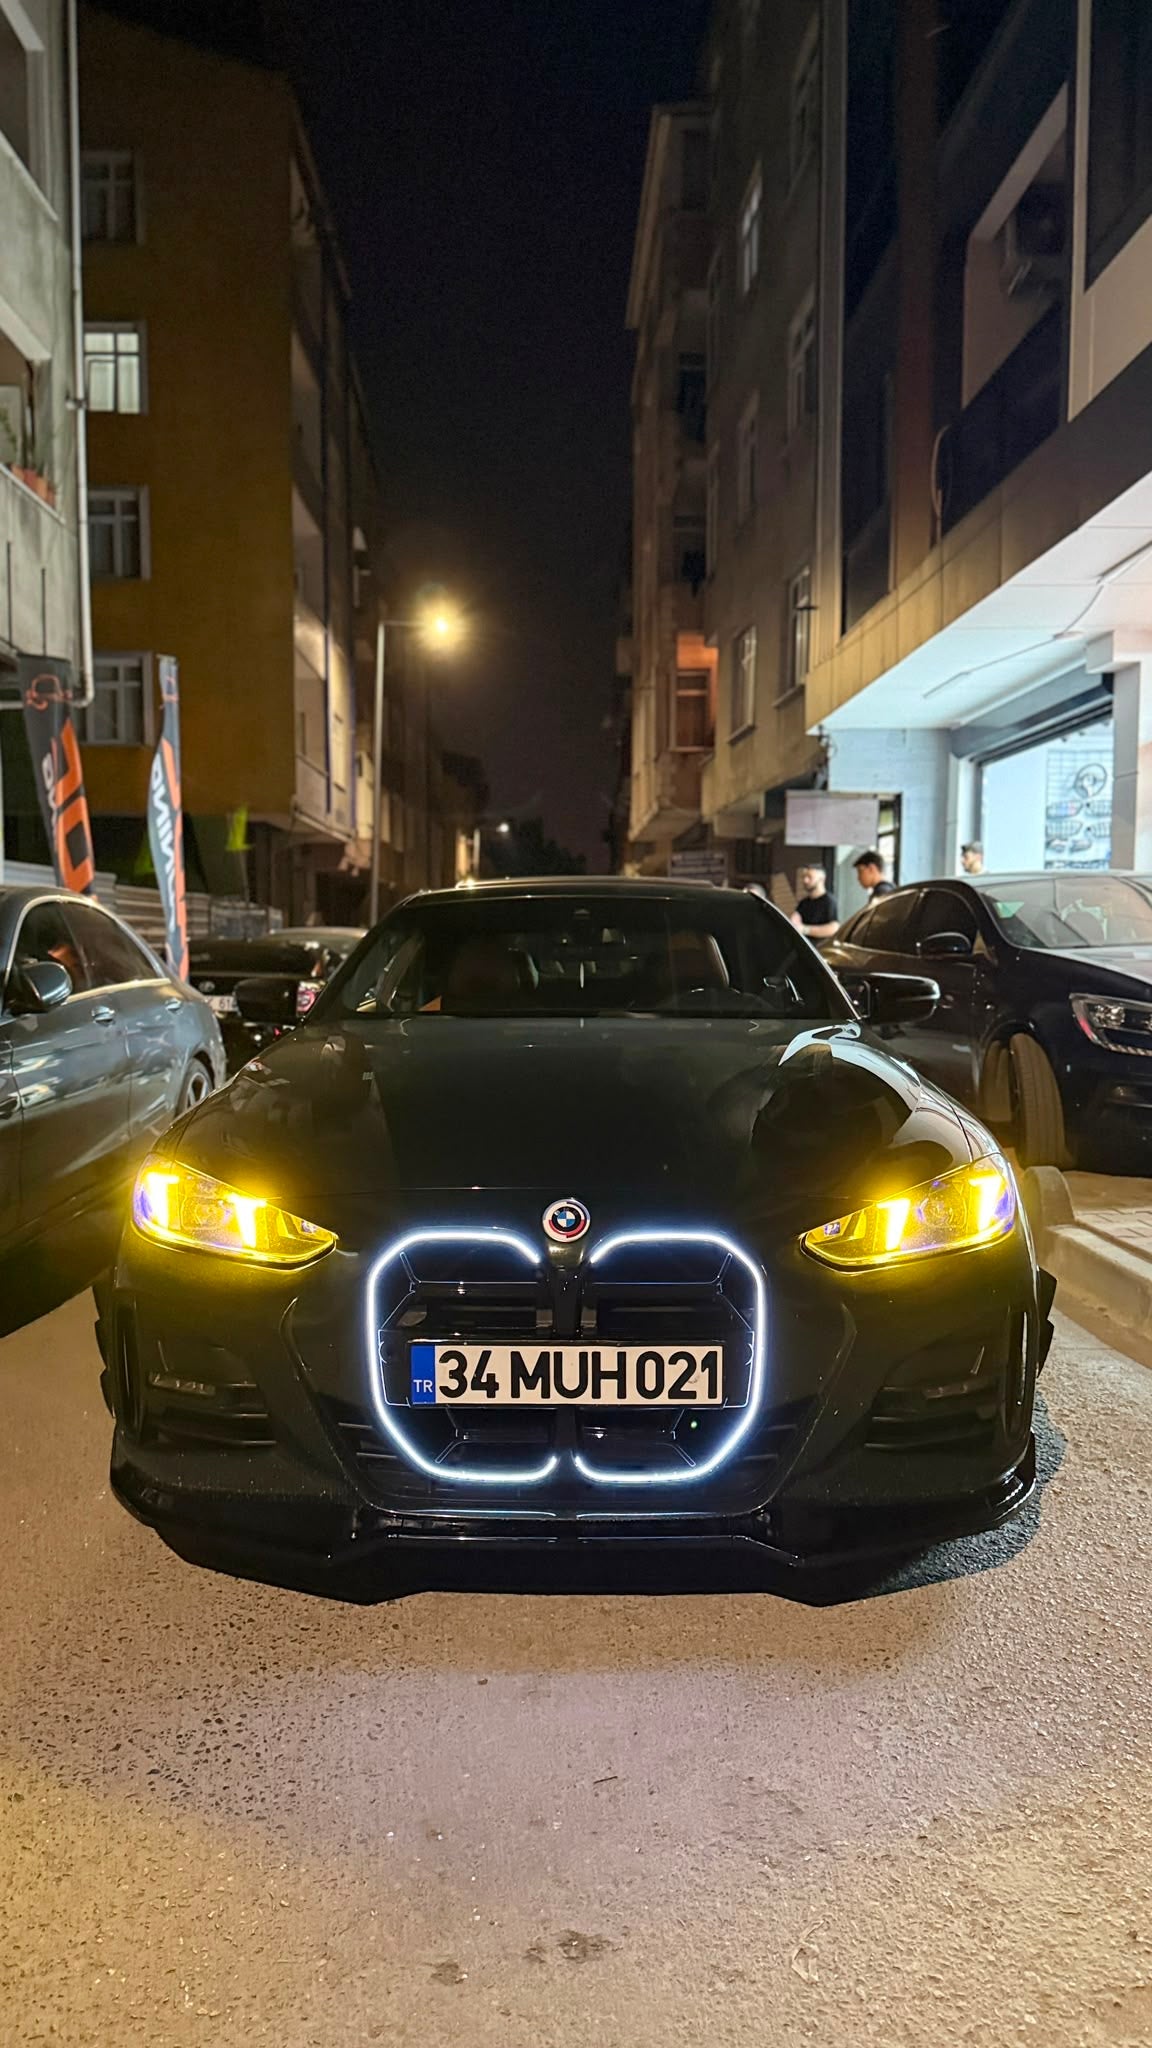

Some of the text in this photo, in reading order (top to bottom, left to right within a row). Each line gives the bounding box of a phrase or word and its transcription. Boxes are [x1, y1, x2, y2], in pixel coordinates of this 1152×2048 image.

[413, 1379, 433, 1393] TR
[439, 1350, 718, 1399] 34 MUH 021
